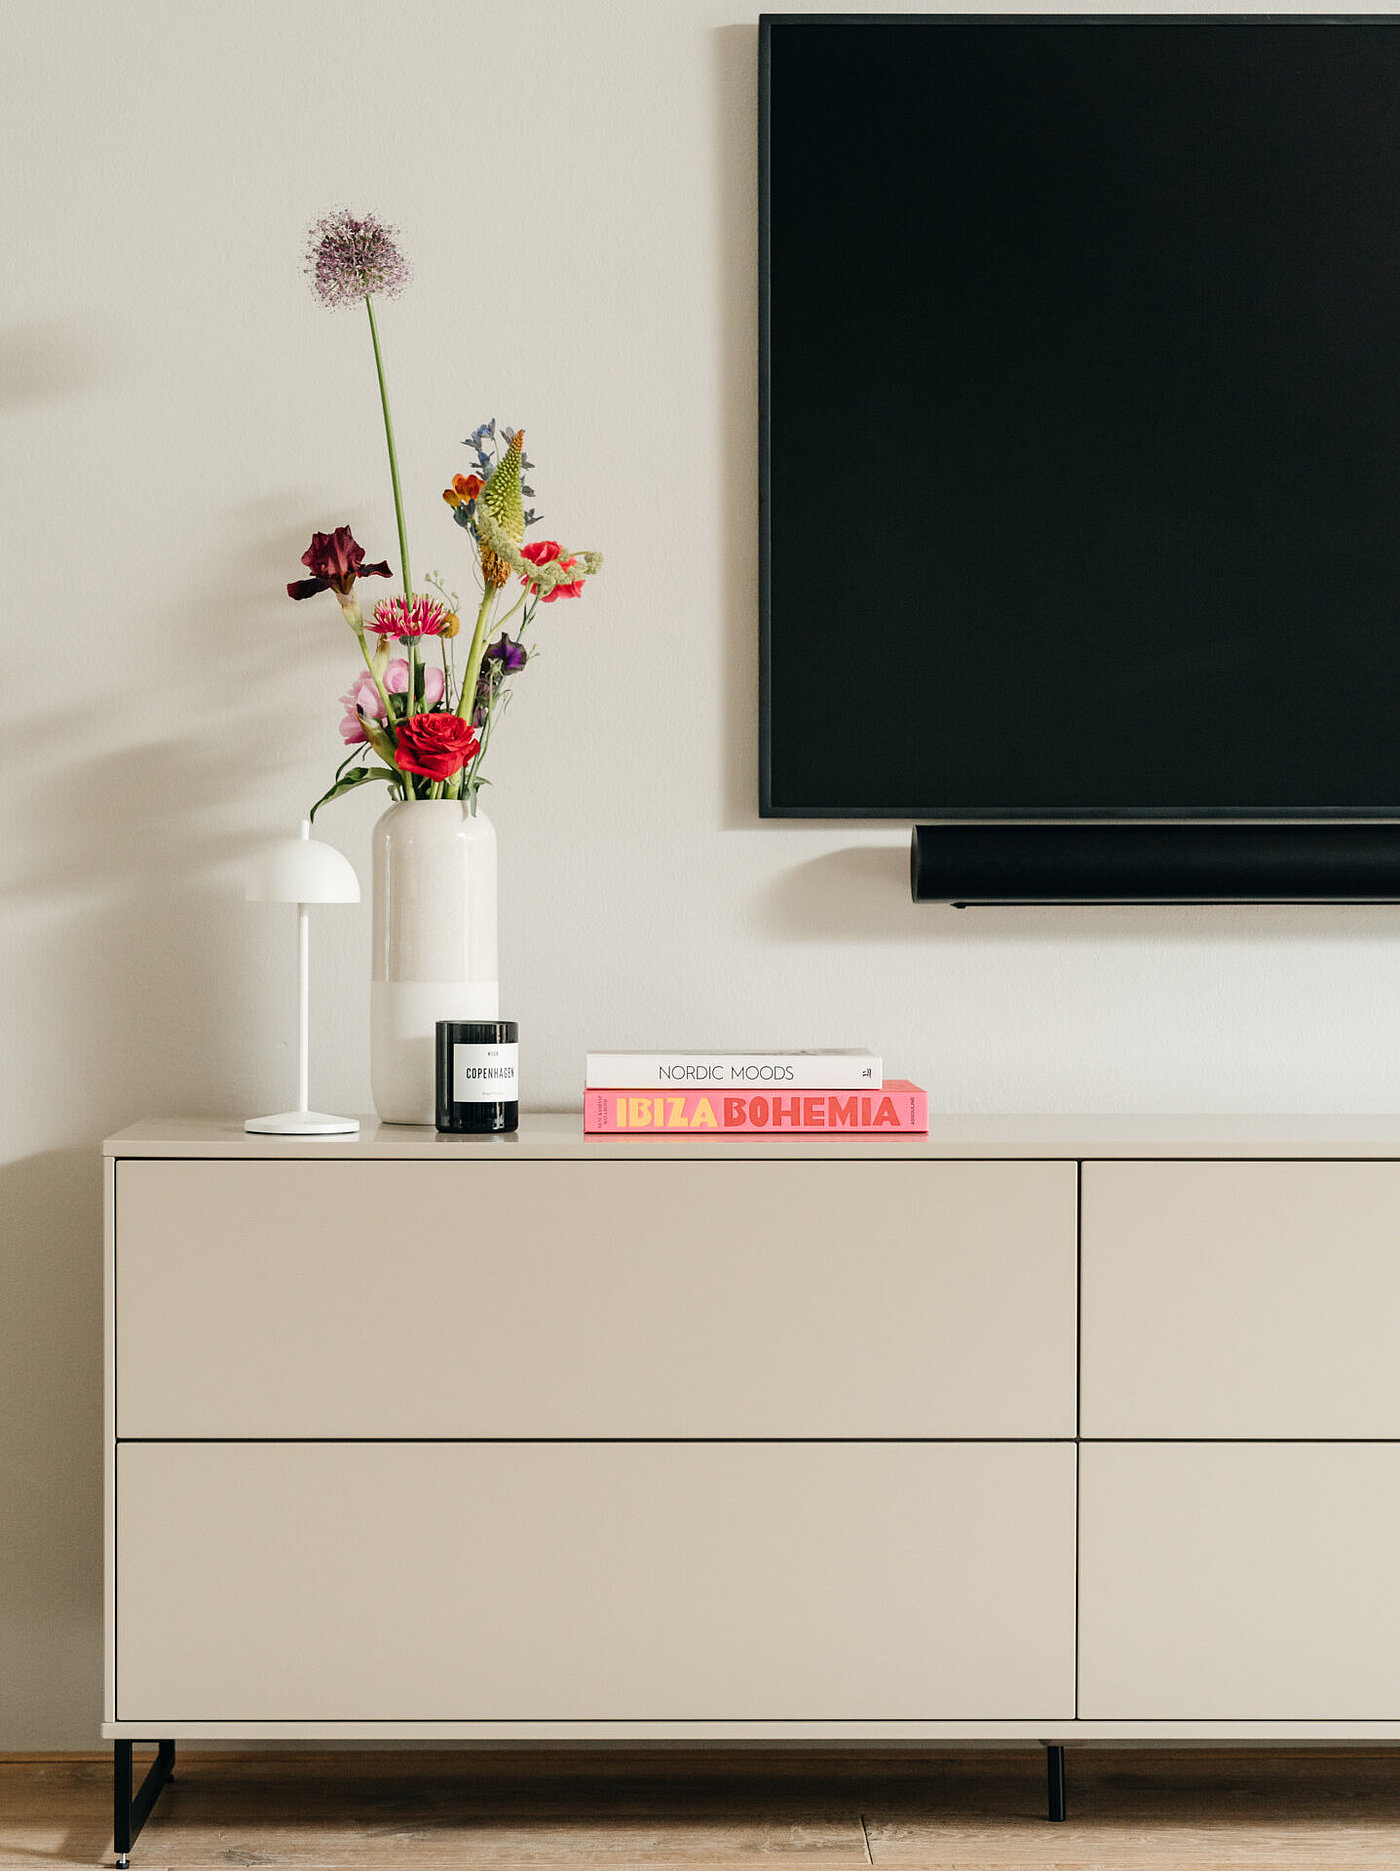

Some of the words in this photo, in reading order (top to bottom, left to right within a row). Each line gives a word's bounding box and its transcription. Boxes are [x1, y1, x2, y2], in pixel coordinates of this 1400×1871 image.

[466, 1066, 514, 1079] COPENHAGEN
[658, 1065, 724, 1080] NORDIC
[731, 1065, 794, 1080] MOODS
[616, 1097, 719, 1128] IBIZA
[723, 1096, 900, 1128] BOHEMIA
